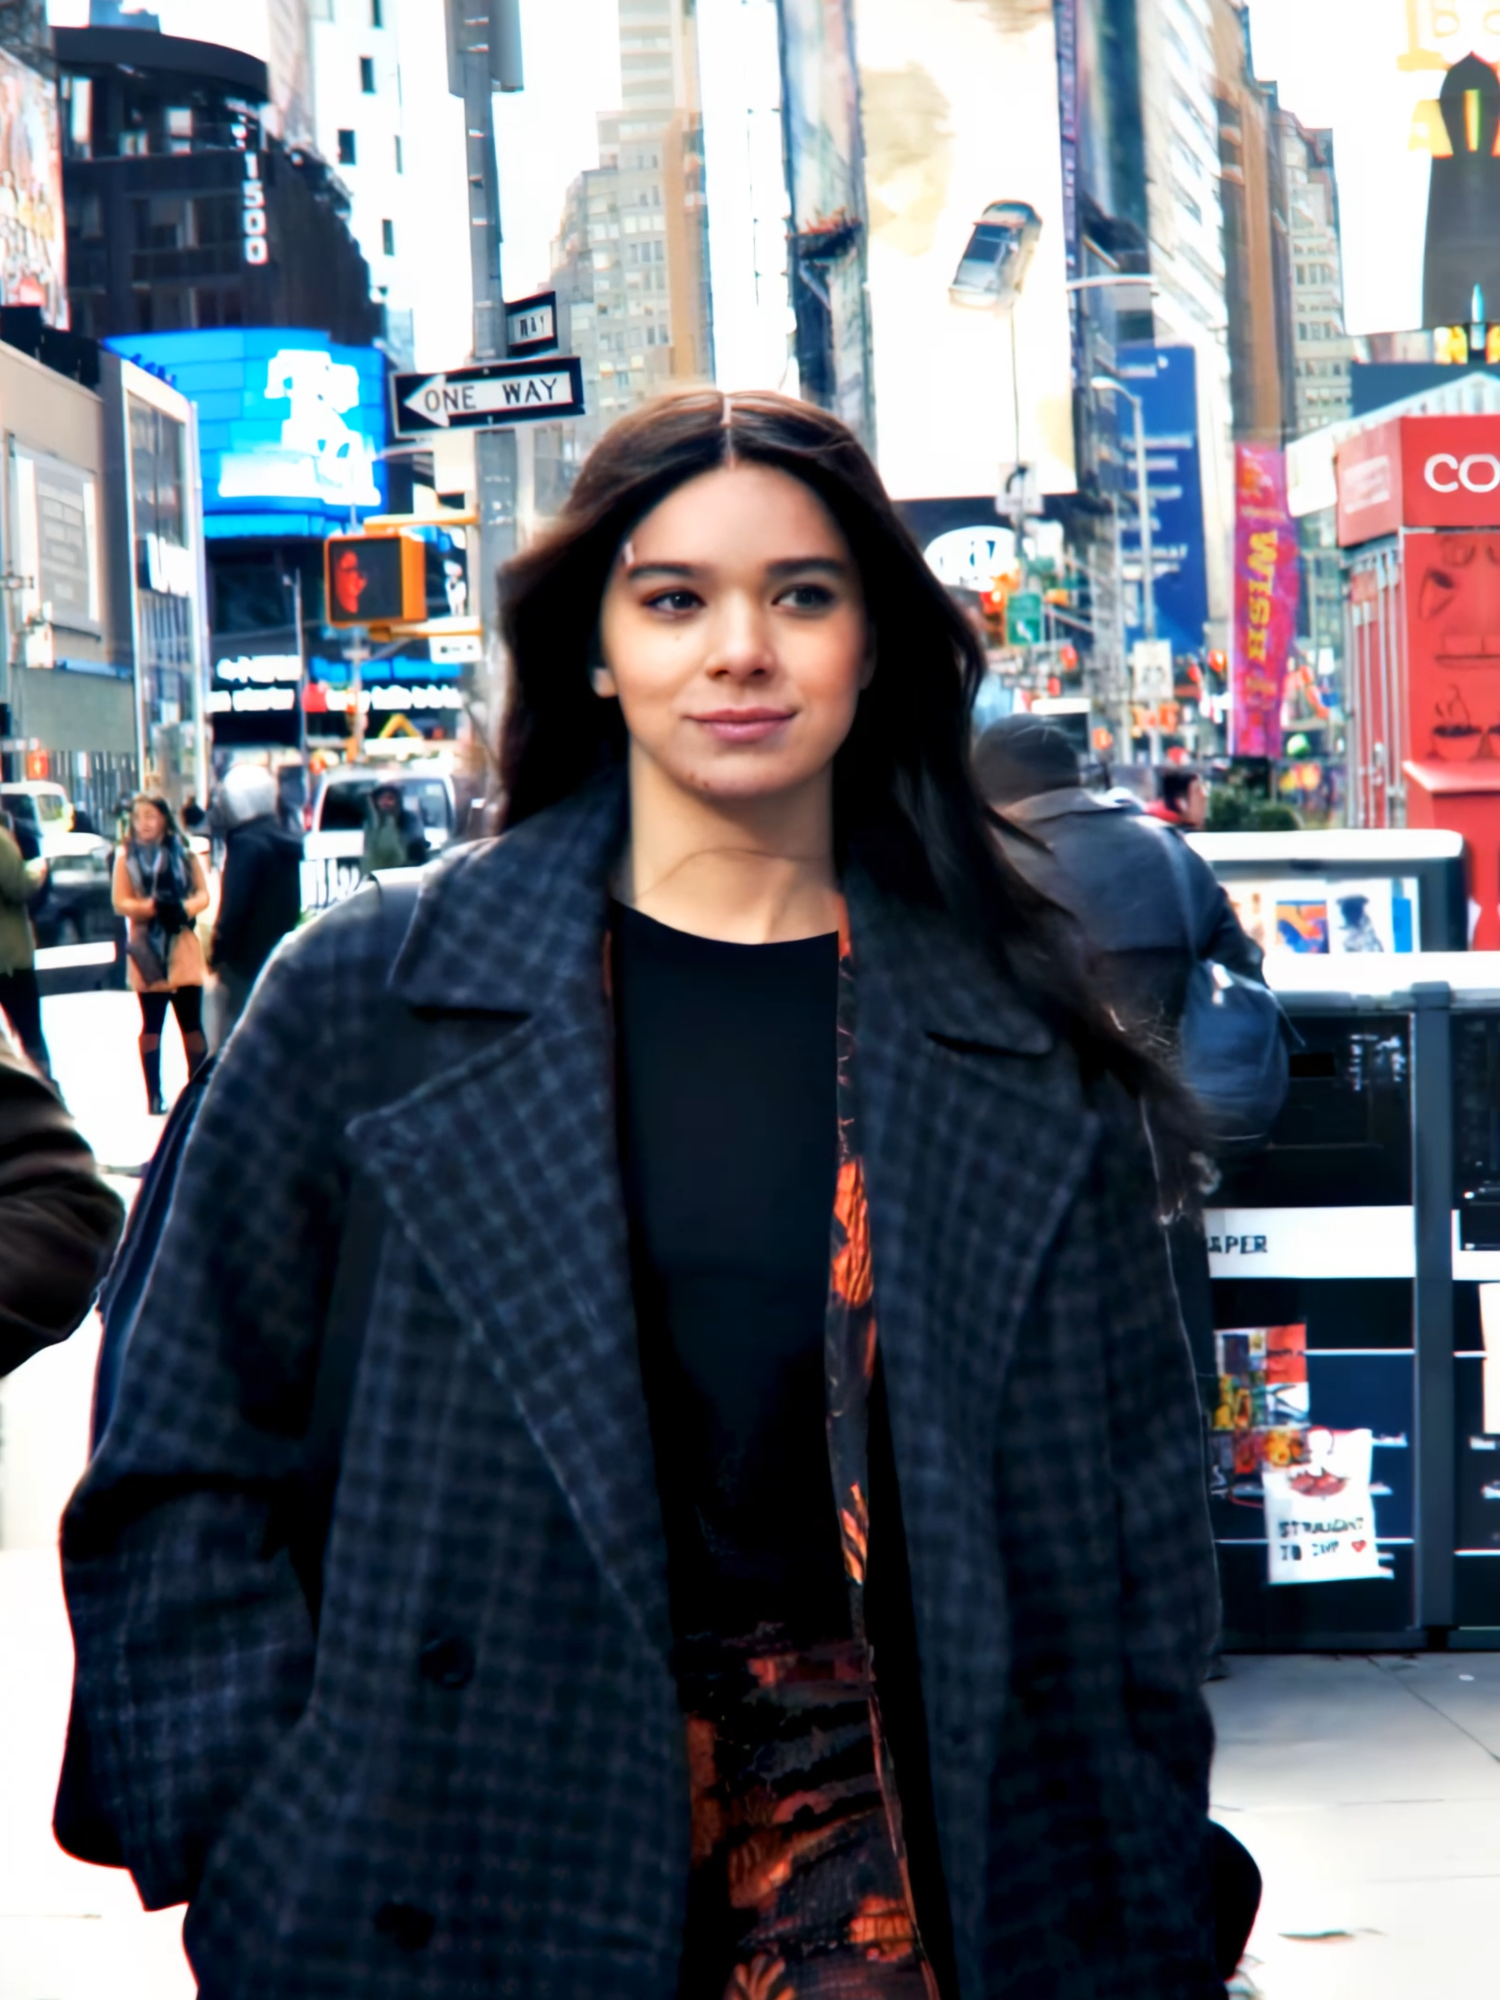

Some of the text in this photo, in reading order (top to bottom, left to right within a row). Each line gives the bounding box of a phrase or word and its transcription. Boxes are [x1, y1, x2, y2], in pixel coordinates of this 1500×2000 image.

[424, 377, 557, 413] ONE WAY
[1424, 453, 1500, 493] CO
